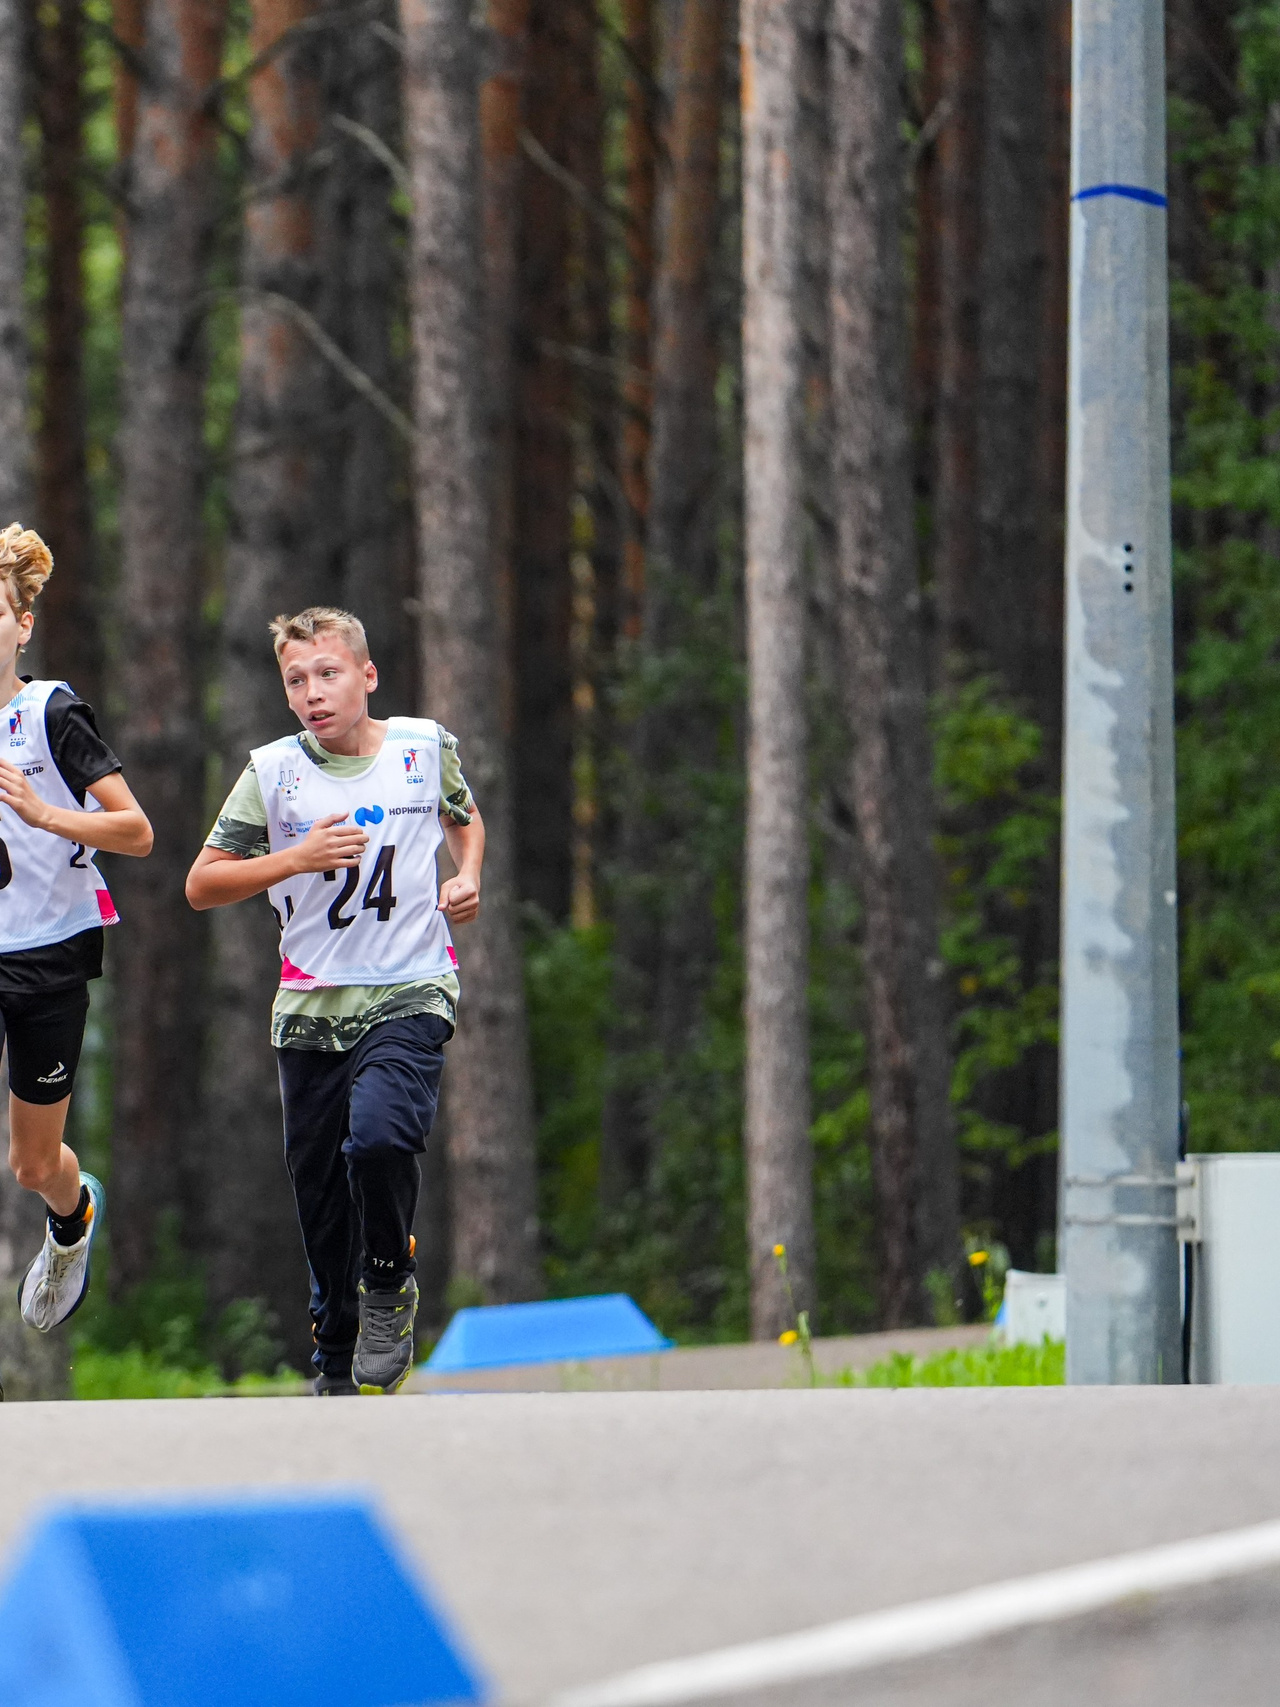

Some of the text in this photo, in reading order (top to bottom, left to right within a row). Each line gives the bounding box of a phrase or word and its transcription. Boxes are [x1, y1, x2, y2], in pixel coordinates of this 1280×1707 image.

[323, 845, 397, 930] 24
[37, 1073, 68, 1084] DEMIX
[372, 1257, 395, 1268] 174
